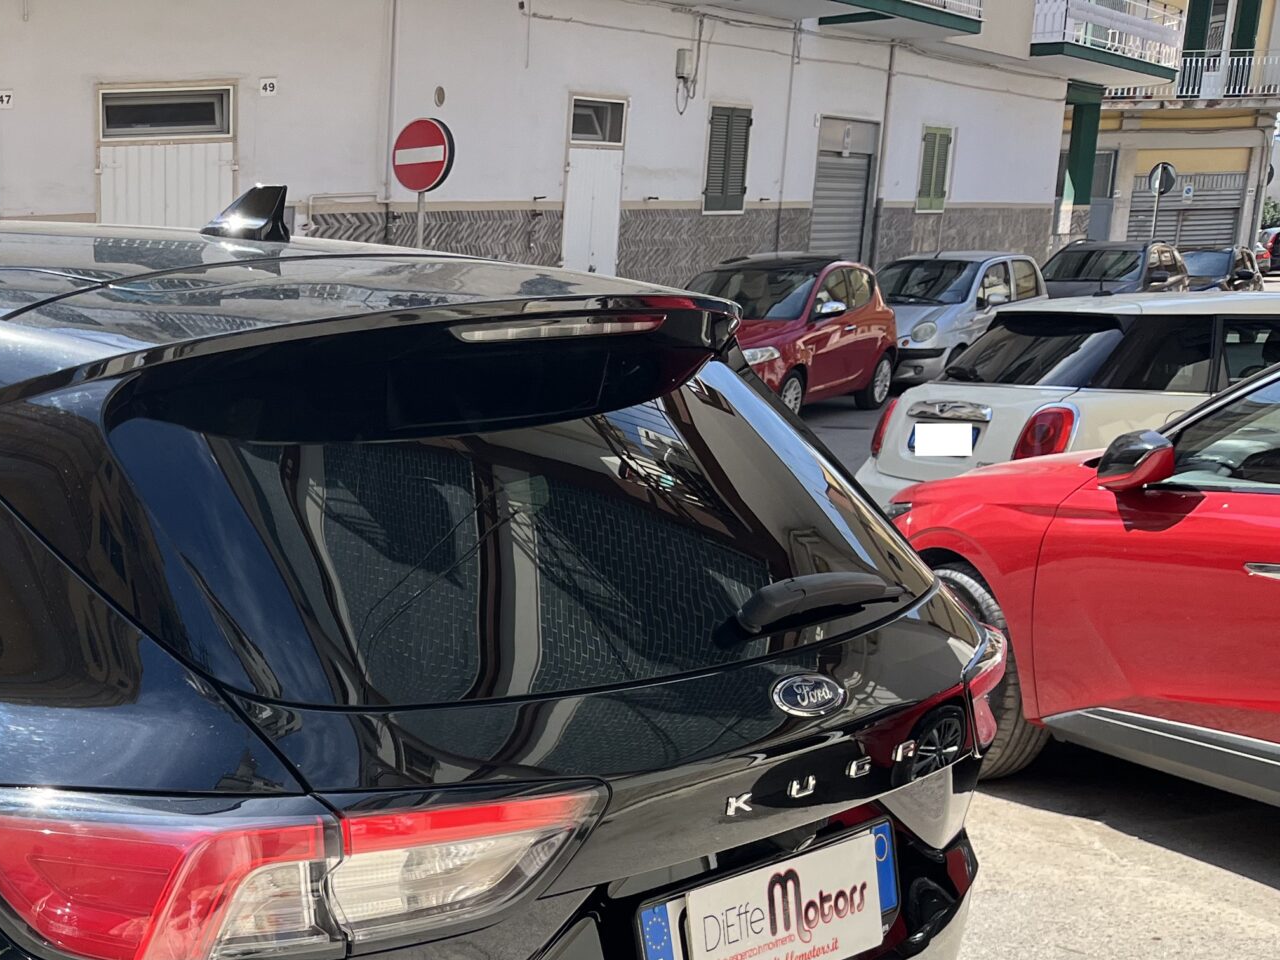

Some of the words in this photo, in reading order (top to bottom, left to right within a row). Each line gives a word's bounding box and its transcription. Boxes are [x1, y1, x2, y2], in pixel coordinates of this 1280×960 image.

[261, 82, 275, 92] 49
[793, 680, 833, 707] Ford
[703, 902, 765, 952] DiEffe
